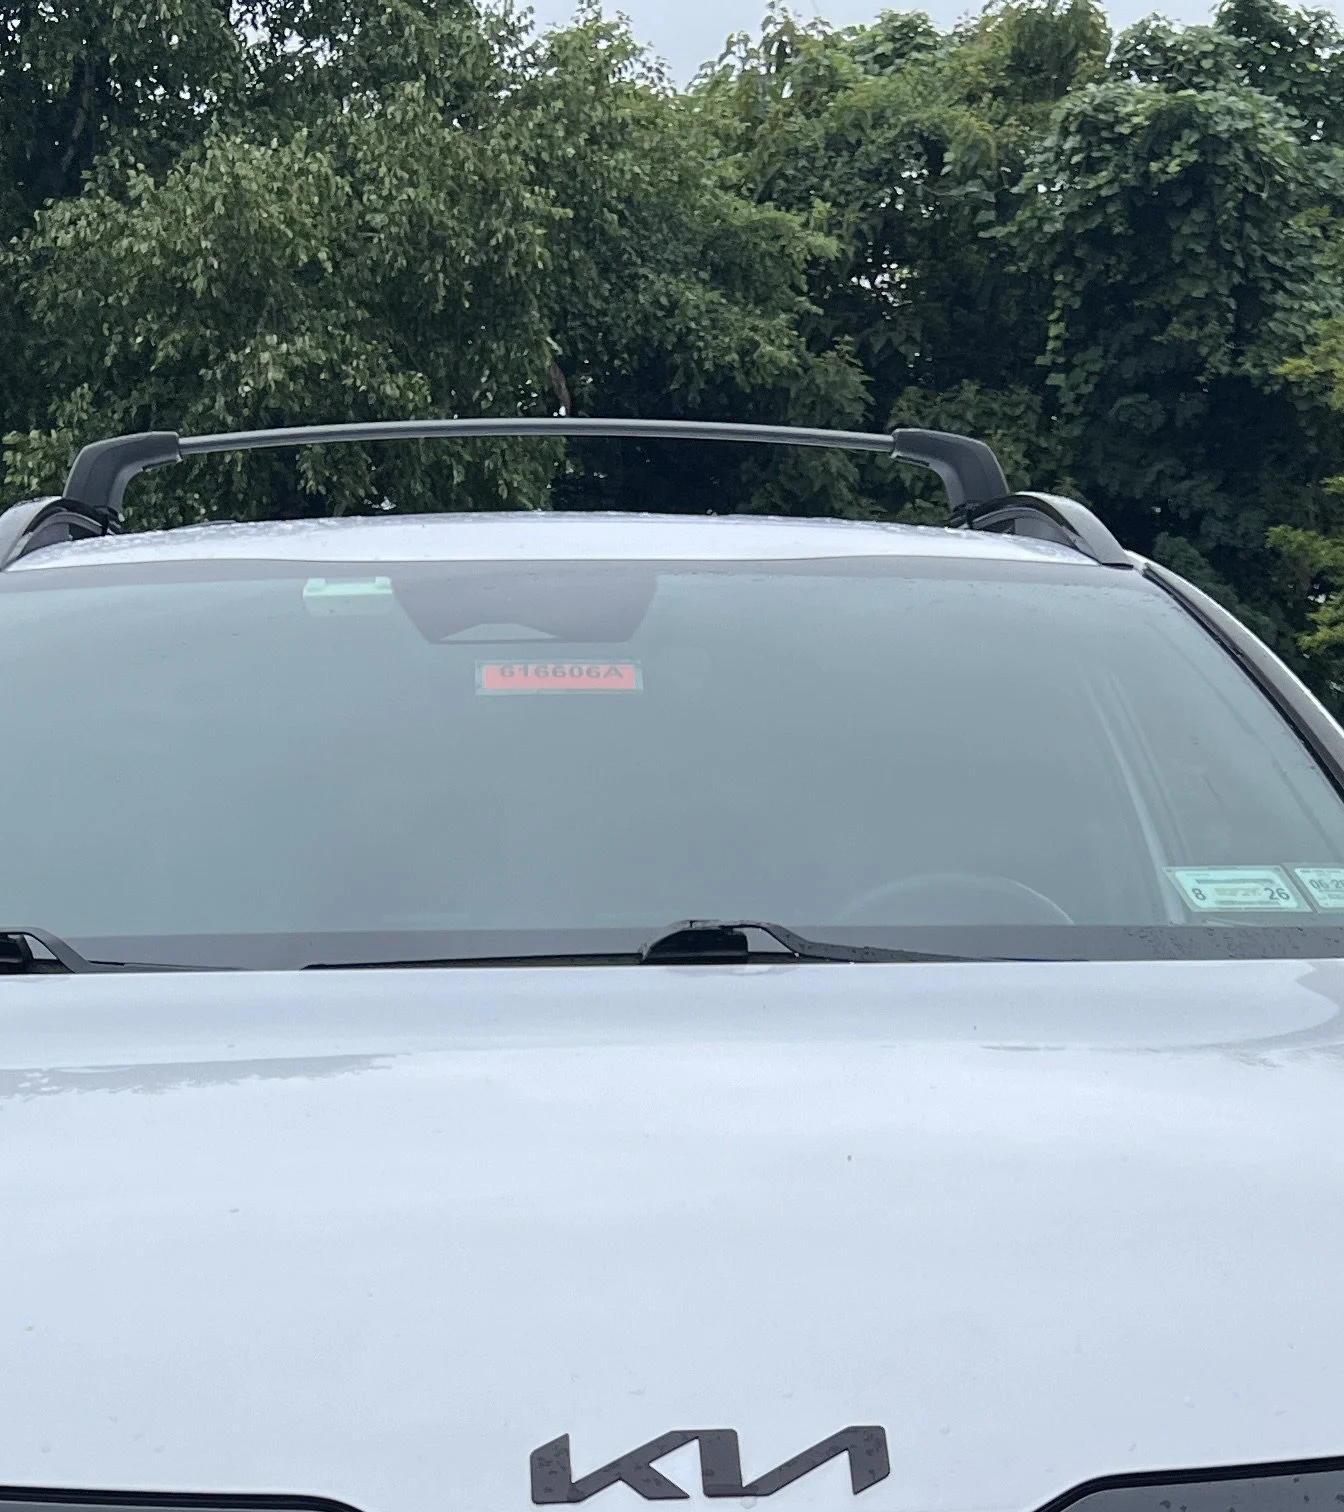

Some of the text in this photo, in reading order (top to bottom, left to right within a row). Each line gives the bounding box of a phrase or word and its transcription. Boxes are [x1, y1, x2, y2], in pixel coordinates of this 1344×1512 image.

[499, 664, 624, 679] 616606A
[1191, 887, 1207, 901] 8
[1263, 887, 1291, 901] 26
